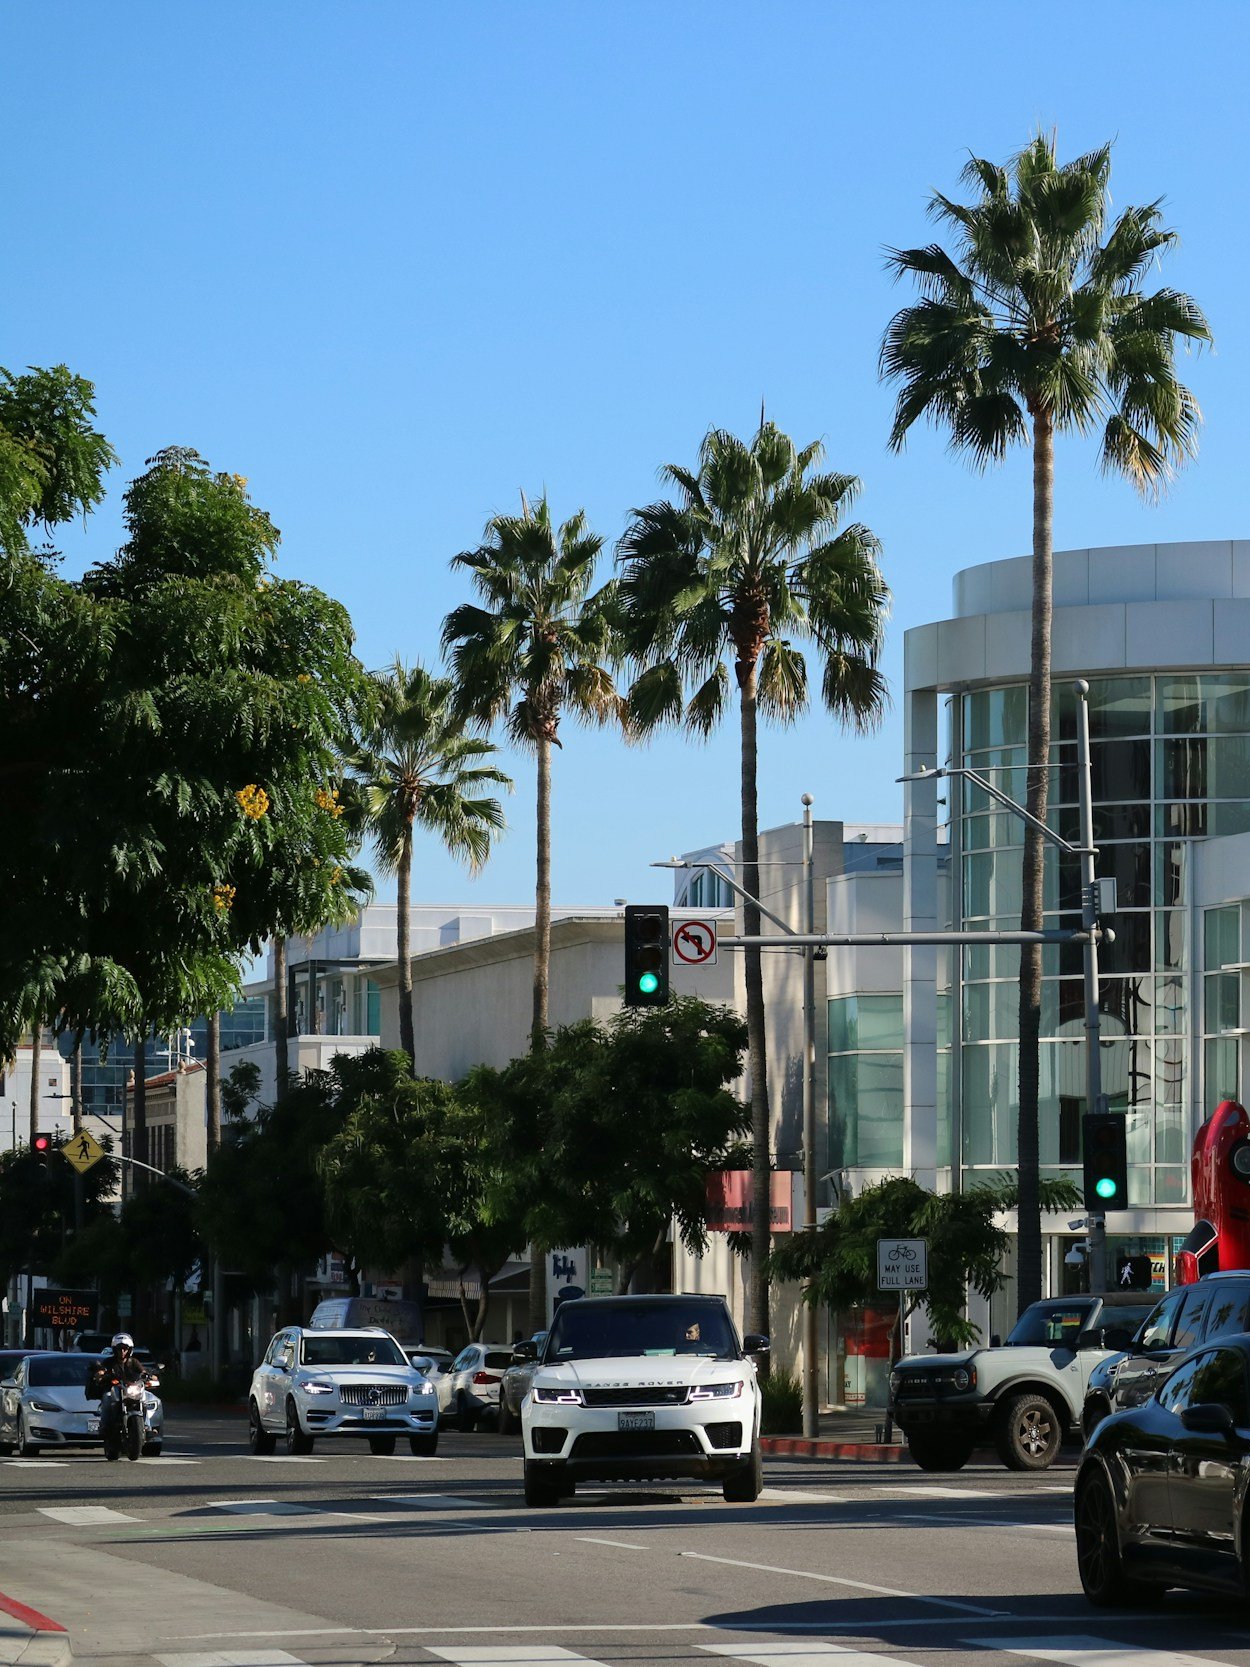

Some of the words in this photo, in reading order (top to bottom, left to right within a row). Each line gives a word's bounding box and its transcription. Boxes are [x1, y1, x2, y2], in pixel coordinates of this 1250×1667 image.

[885, 1265, 900, 1273] MAY
[905, 1264, 920, 1273] USE
[881, 1277, 900, 1285] FULL
[905, 1276, 924, 1285] LANE
[59, 1296, 72, 1305] ON
[40, 1305, 90, 1316] WILSHIRE
